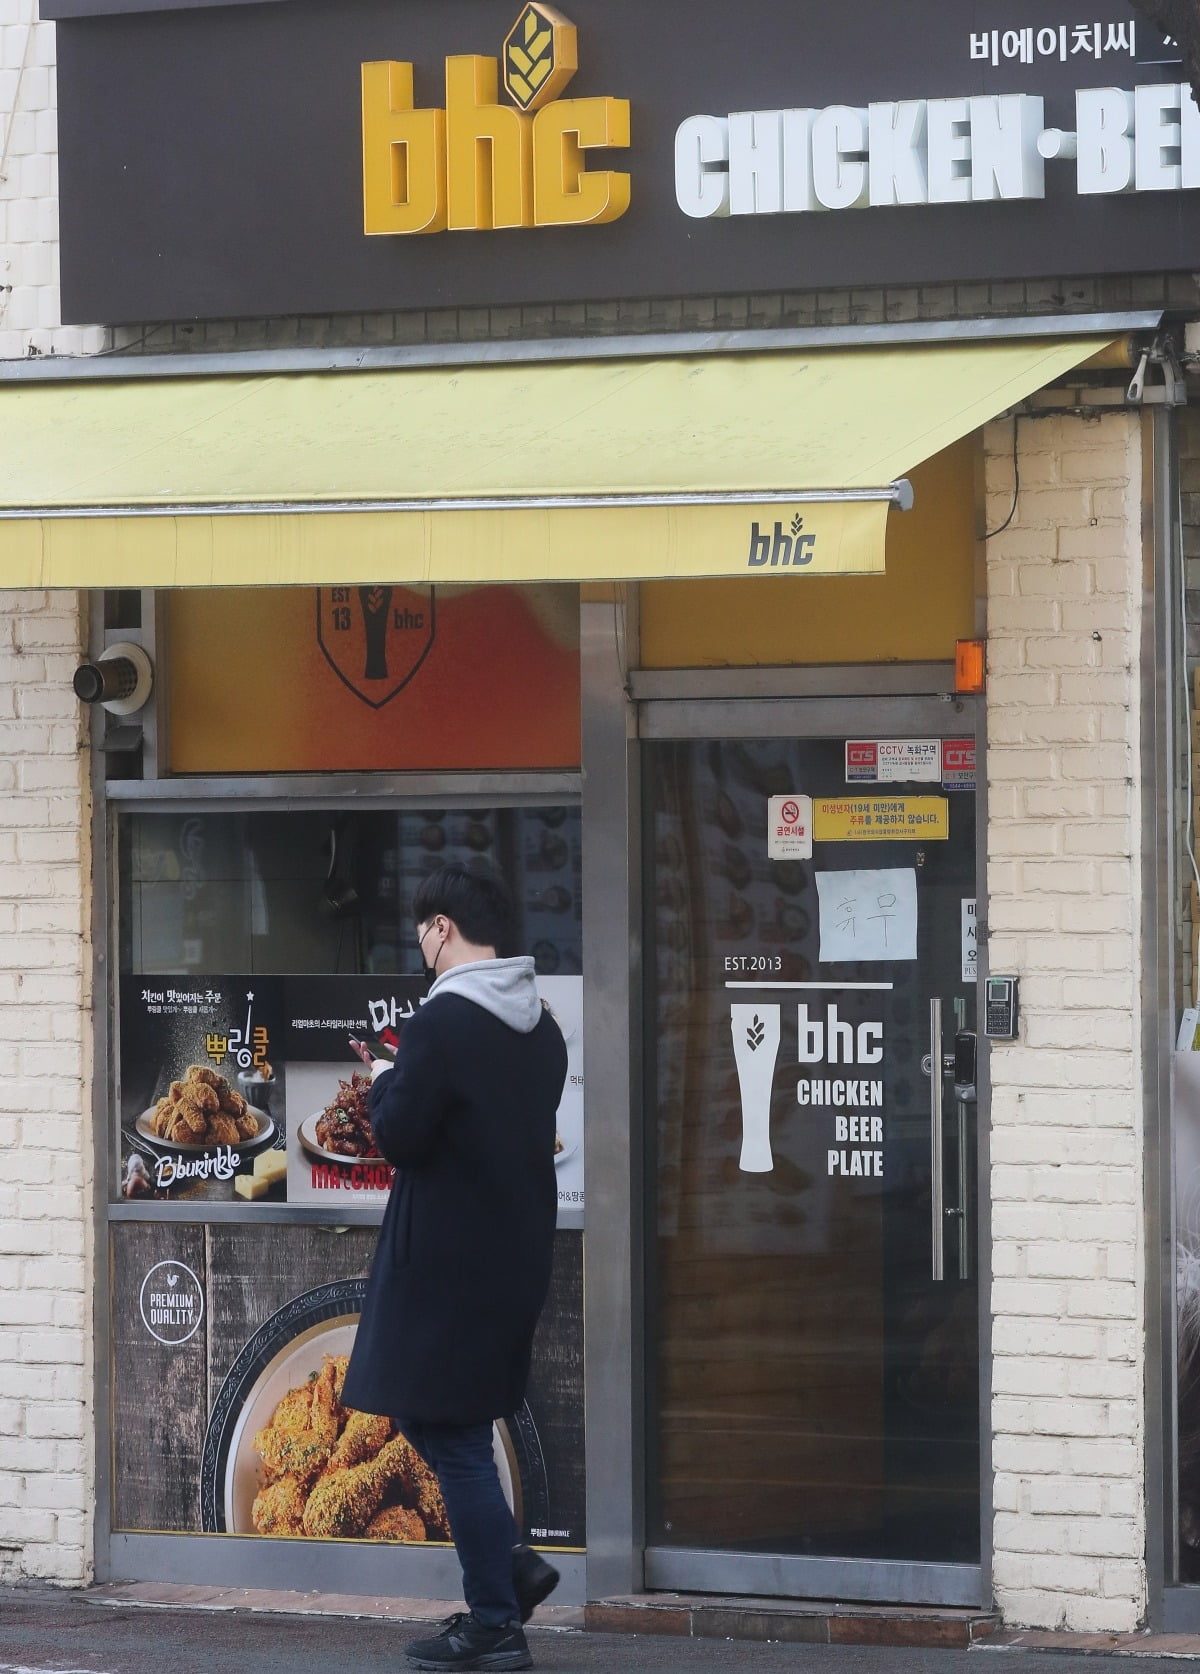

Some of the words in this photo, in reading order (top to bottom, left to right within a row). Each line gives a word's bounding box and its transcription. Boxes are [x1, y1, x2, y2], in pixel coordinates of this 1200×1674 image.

[970, 20, 1136, 66] 비에이치씨
[361, 55, 631, 236] bhc
[748, 522, 816, 566] bhc
[332, 607, 351, 630] 13
[394, 608, 424, 629] bhc
[880, 745, 904, 755] CCTV
[907, 745, 937, 756] 녹화구역
[875, 815, 905, 825] 제공하지
[908, 814, 939, 824] 않습니다.
[776, 827, 805, 837] 금연시설
[724, 956, 782, 971] EST.2013
[141, 989, 164, 1003] 치킨이
[166, 989, 204, 1003] 맛있어지는
[205, 989, 222, 1003] 주문
[206, 1005, 269, 1067] 뿌링클
[798, 1004, 883, 1063] bhc
[797, 1080, 883, 1106] CHICKEN
[836, 1116, 883, 1142] BEER
[828, 1151, 884, 1176] PLATE
[150, 1293, 194, 1308] PREMIUM
[150, 1308, 194, 1326] QUALITY
